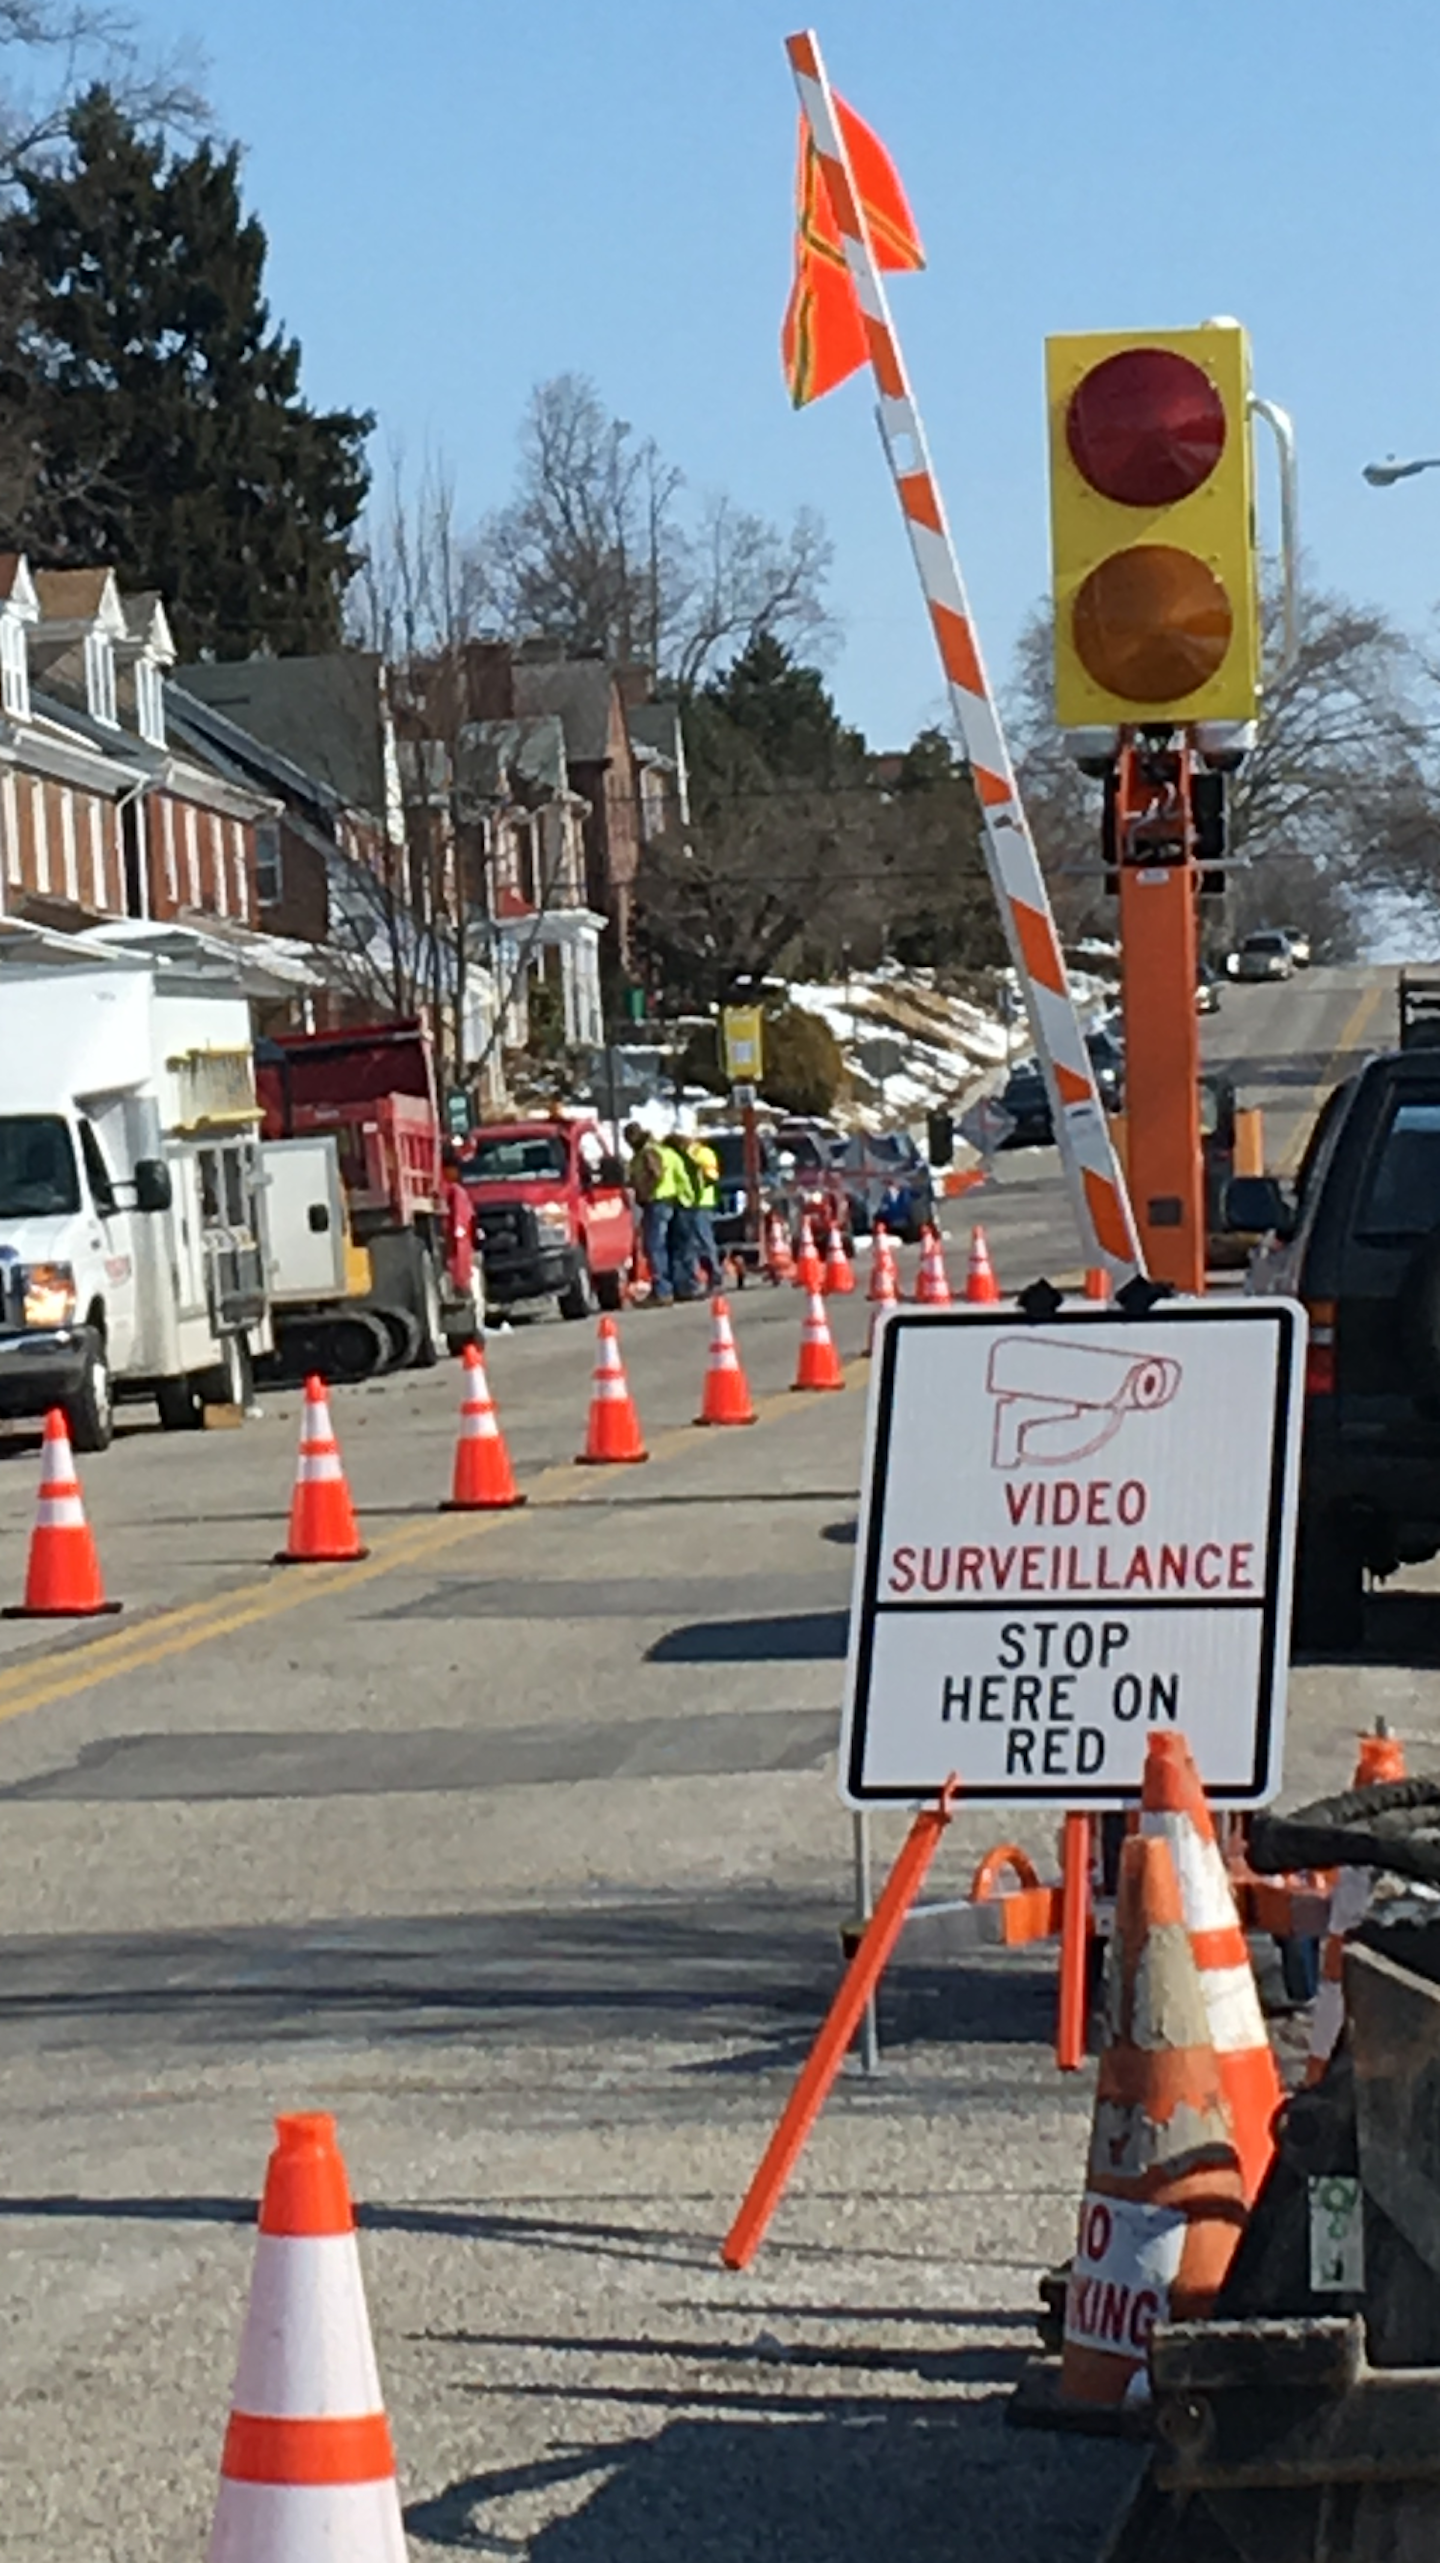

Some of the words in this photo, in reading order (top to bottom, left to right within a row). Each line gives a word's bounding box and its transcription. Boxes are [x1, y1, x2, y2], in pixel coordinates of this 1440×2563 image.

[1006, 1480, 1148, 1526] VIDEO
[889, 1543, 1254, 1592] SURVEILLANCE
[998, 1622, 1130, 1668] STOP
[941, 1675, 1077, 1722] HERE
[1113, 1673, 1179, 1720] ON
[1006, 1728, 1106, 1775] RED
